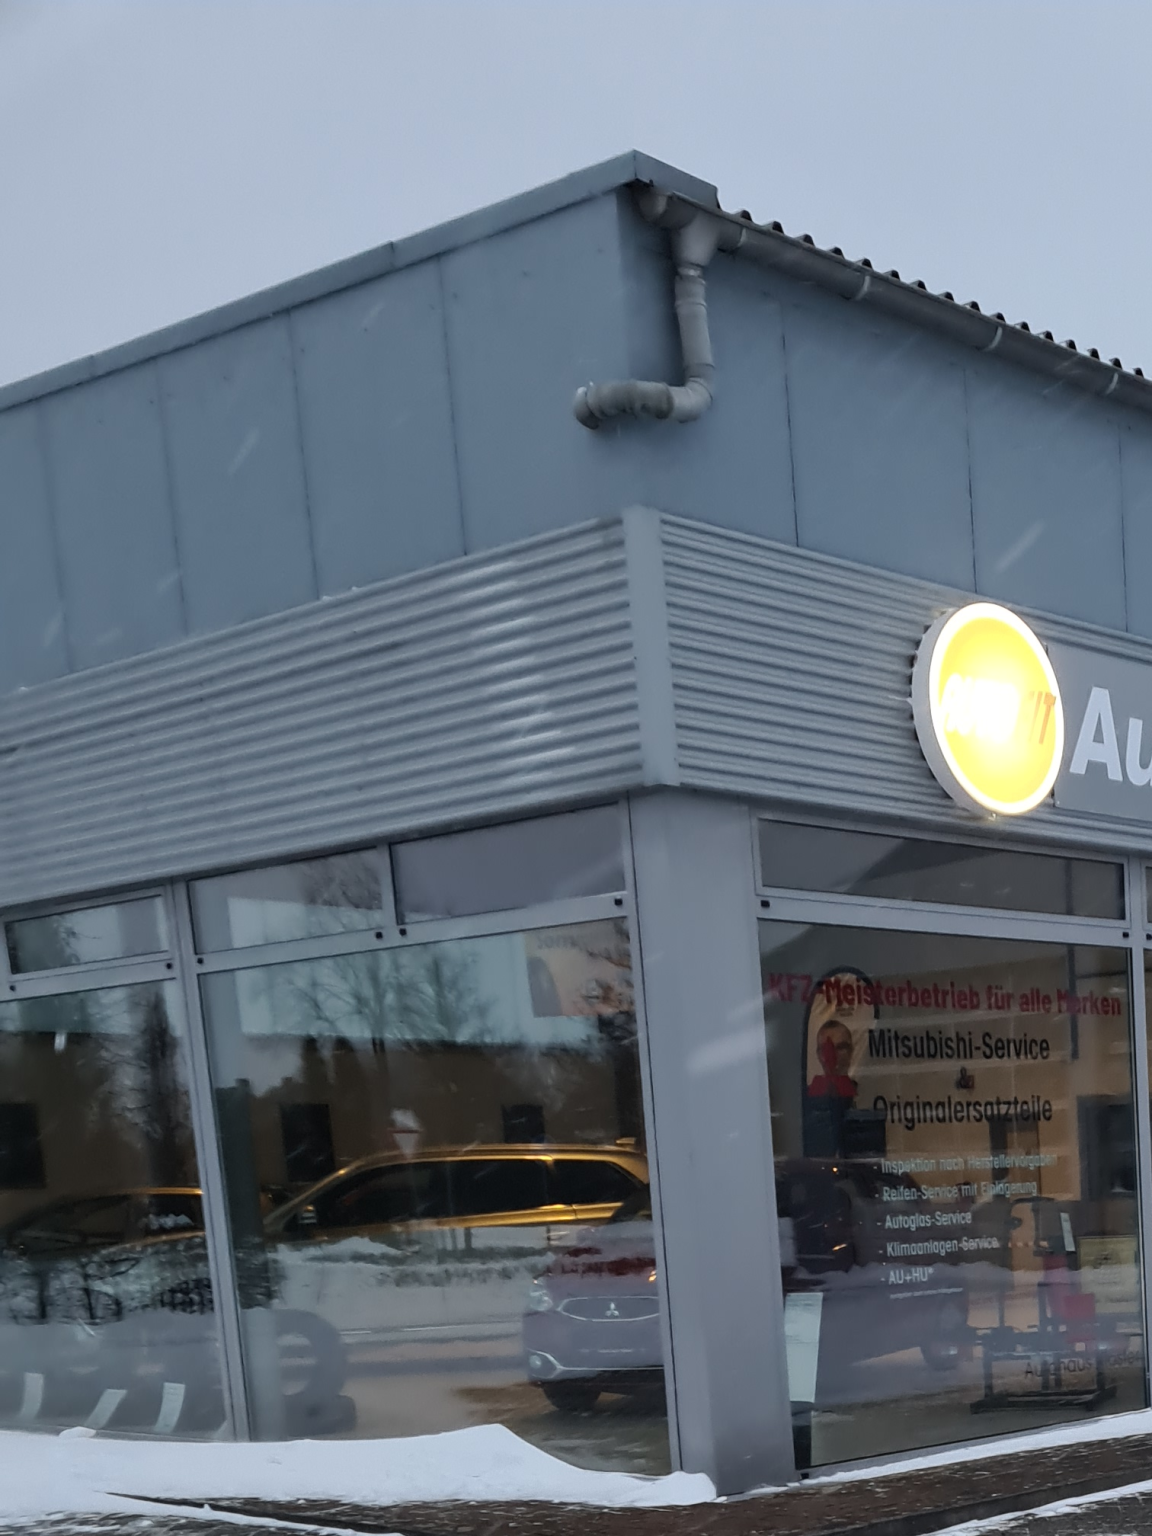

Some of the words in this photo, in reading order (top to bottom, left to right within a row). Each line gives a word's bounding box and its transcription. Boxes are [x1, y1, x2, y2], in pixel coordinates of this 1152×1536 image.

[768, 973, 981, 1010] KFZ-Meisterbetrieb
[986, 984, 1014, 1011] für
[1019, 987, 1052, 1014] alle
[1056, 988, 1122, 1016] Marken
[868, 1028, 1050, 1061] Mitsubishi-Service
[955, 1066, 975, 1090] &
[873, 1094, 1053, 1131] Originalersatzteile
[881, 1157, 936, 1176] Inspektion
[939, 1157, 965, 1171] nach
[883, 1183, 958, 1202] Reifen-Service
[961, 1183, 978, 1197] mit
[885, 1210, 973, 1232] Autoglas-Service
[886, 1234, 1000, 1258] Klimaanlagen-Service
[1025, 1357, 1092, 1379] Auohaus
